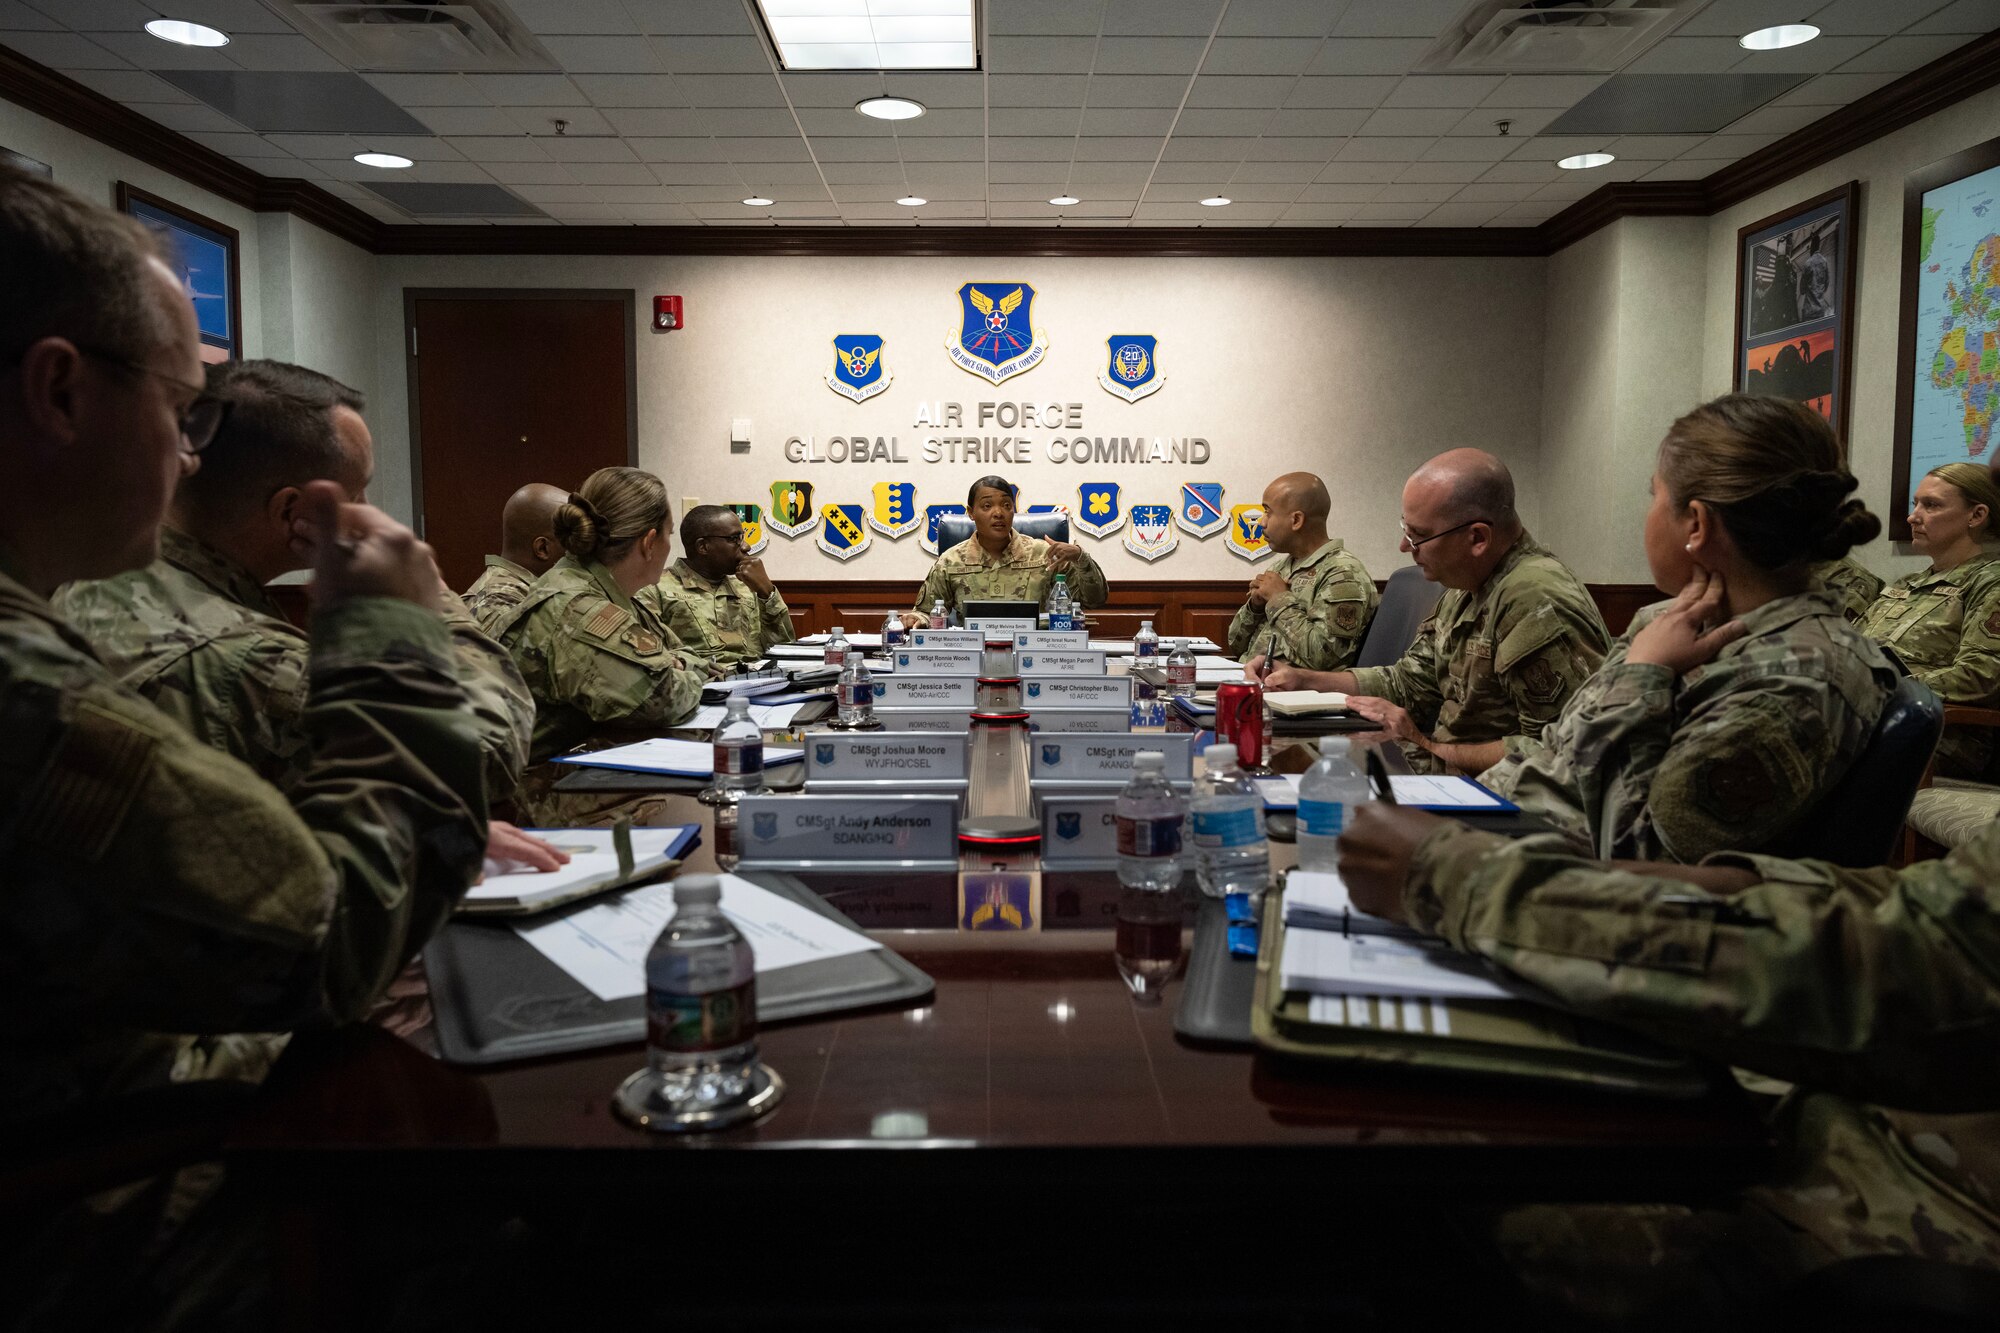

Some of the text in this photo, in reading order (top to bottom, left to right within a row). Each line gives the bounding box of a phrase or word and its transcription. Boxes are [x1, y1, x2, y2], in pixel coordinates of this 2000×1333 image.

[1125, 351, 1138, 360] 20
[951, 346, 1043, 380] AIR FORCE GLOBAL STRIKE COMMAND
[829, 378, 887, 400] EIGHTH AIR FORCE
[914, 401, 1083, 428] AIR FORCE
[784, 437, 1210, 464] GLOBAL STRIKE COMMAND
[917, 655, 934, 663] CMSgt
[1042, 657, 1058, 665] CMSgt
[1059, 657, 1075, 665] Megan
[896, 683, 918, 692] CMSgt
[1049, 684, 1068, 693] CMSgt
[1068, 684, 1102, 693] Christopher
[851, 745, 947, 757] CMSgt Joshua Moore
[1086, 747, 1116, 758] CMSgt
[1118, 747, 1136, 757] Kim
[865, 758, 931, 769] WYJFHQ/CSEL
[795, 813, 931, 830] CMSgt Andy Anderson
[833, 832, 894, 845] SDANG/HQ
